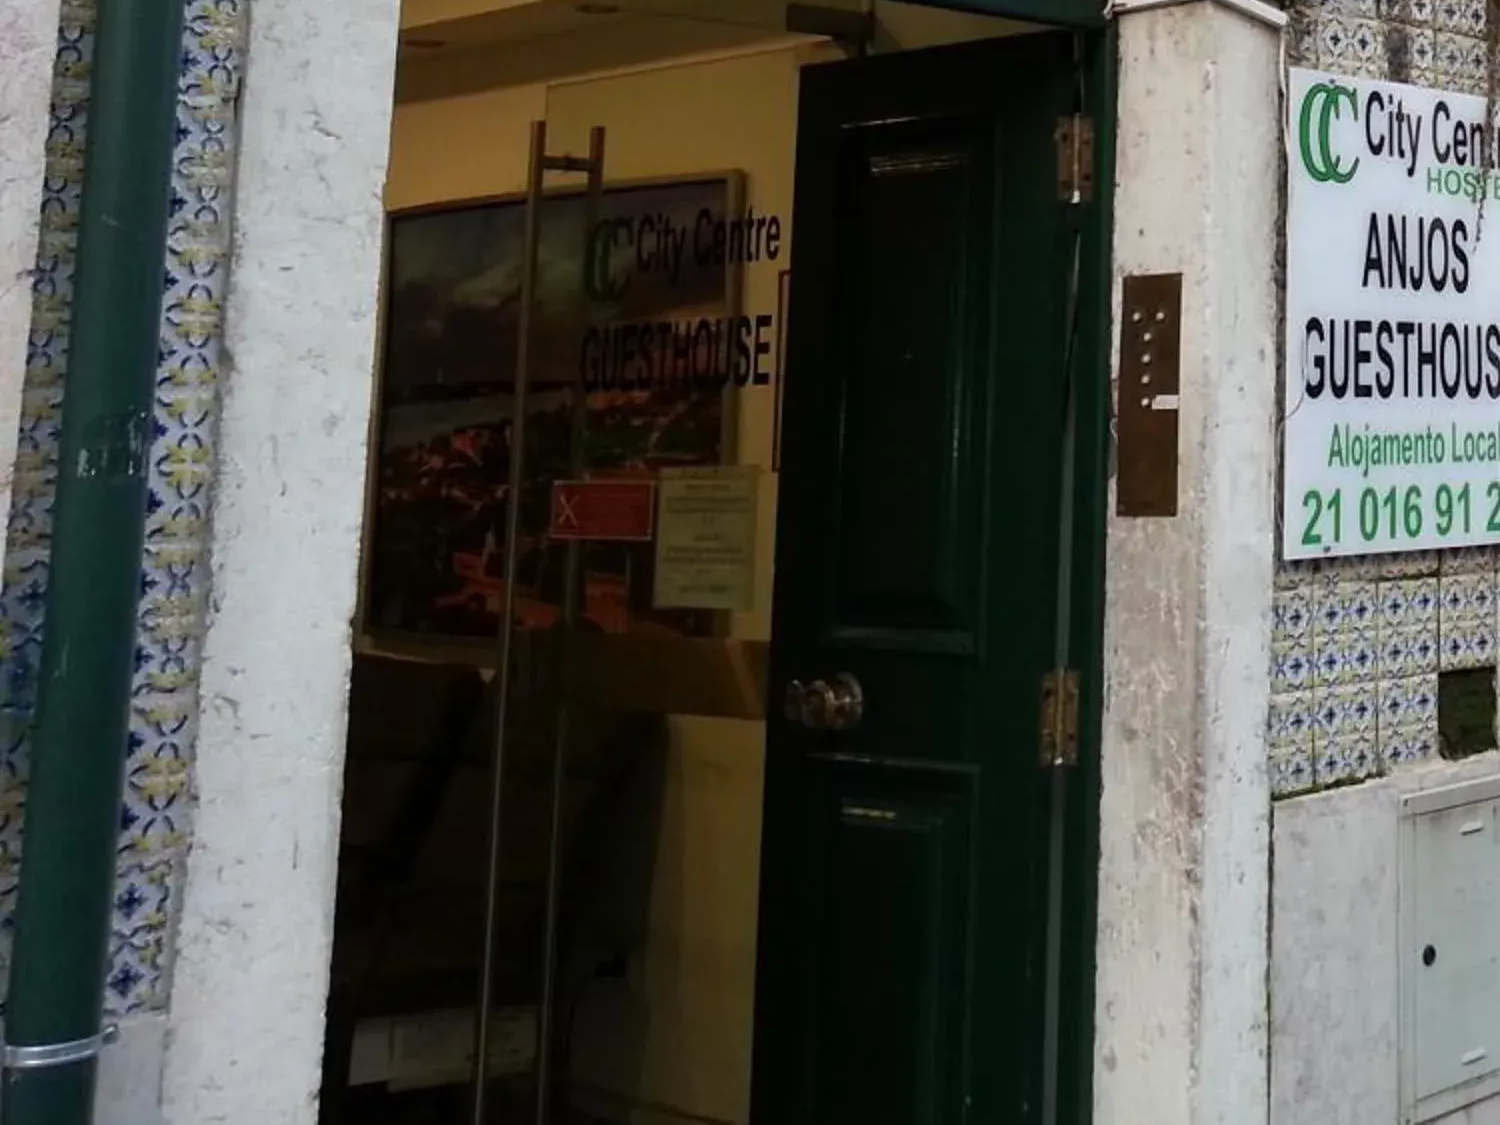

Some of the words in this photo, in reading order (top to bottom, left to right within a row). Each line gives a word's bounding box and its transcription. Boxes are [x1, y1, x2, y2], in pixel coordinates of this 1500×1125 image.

[1364, 90, 1422, 177] City
[635, 214, 686, 283] City
[693, 206, 781, 266] Centre
[1361, 211, 1470, 295] ANJOS
[580, 314, 773, 393] GUESTHOUSE
[1327, 423, 1446, 478] Alojamento
[1301, 487, 1342, 545] 21
[1359, 483, 1423, 542] 016
[1434, 481, 1471, 535] 91
